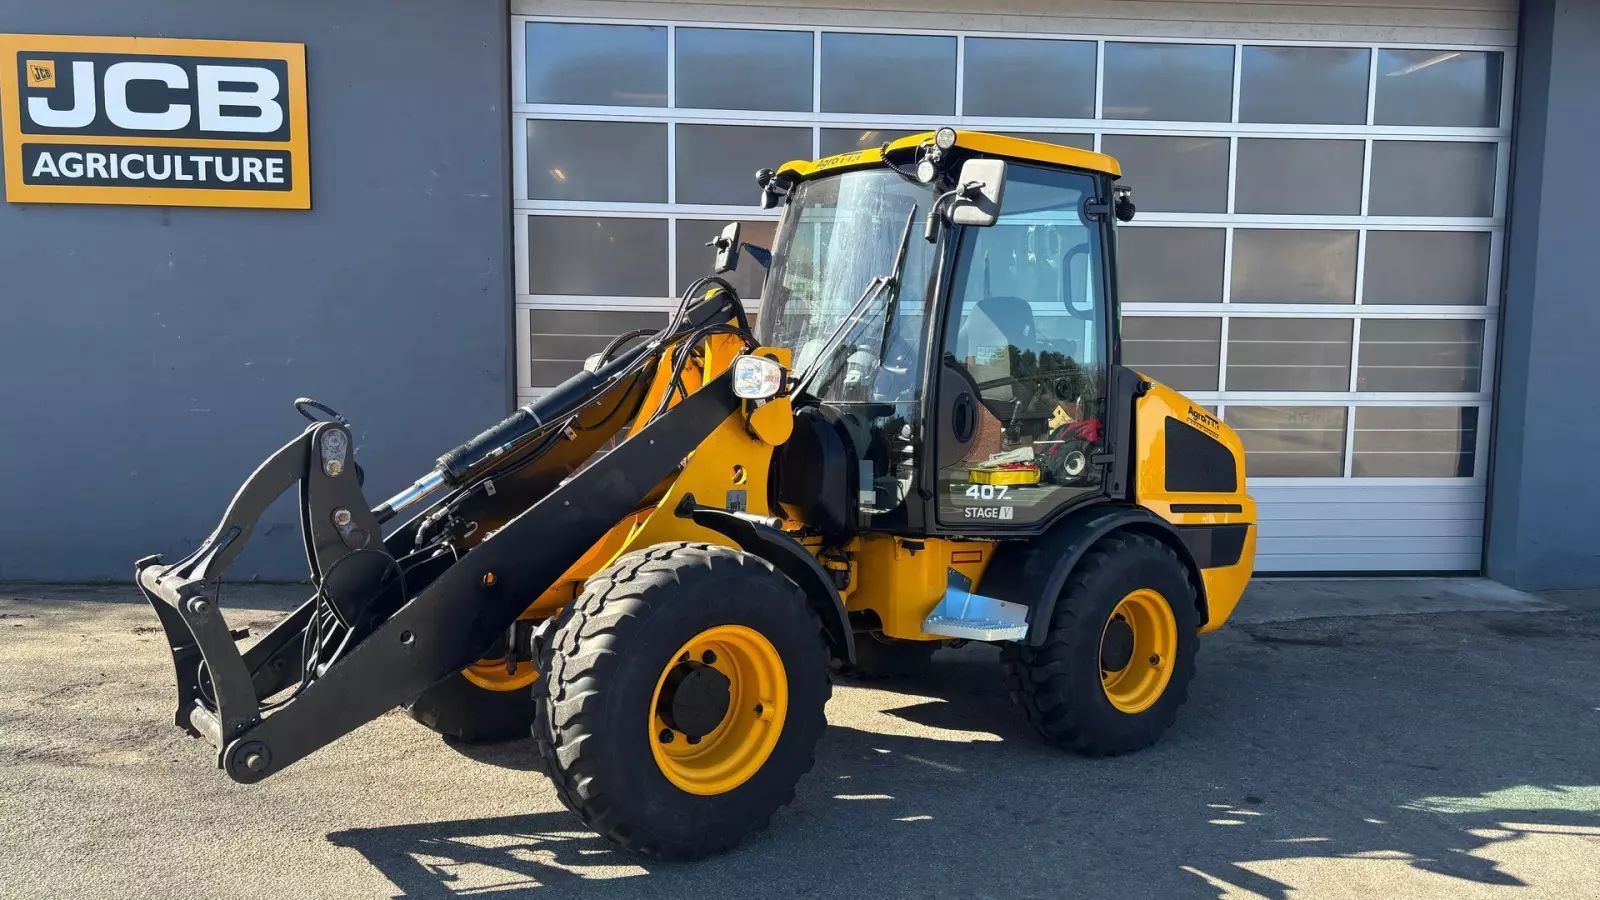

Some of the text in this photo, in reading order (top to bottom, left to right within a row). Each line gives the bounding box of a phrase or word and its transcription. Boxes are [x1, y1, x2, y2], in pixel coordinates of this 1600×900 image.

[33, 66, 52, 81] JCB
[28, 61, 284, 133] JCB
[32, 152, 285, 183] AGRICULTURE
[966, 485, 1009, 500] 407
[965, 507, 999, 518] STAGE
